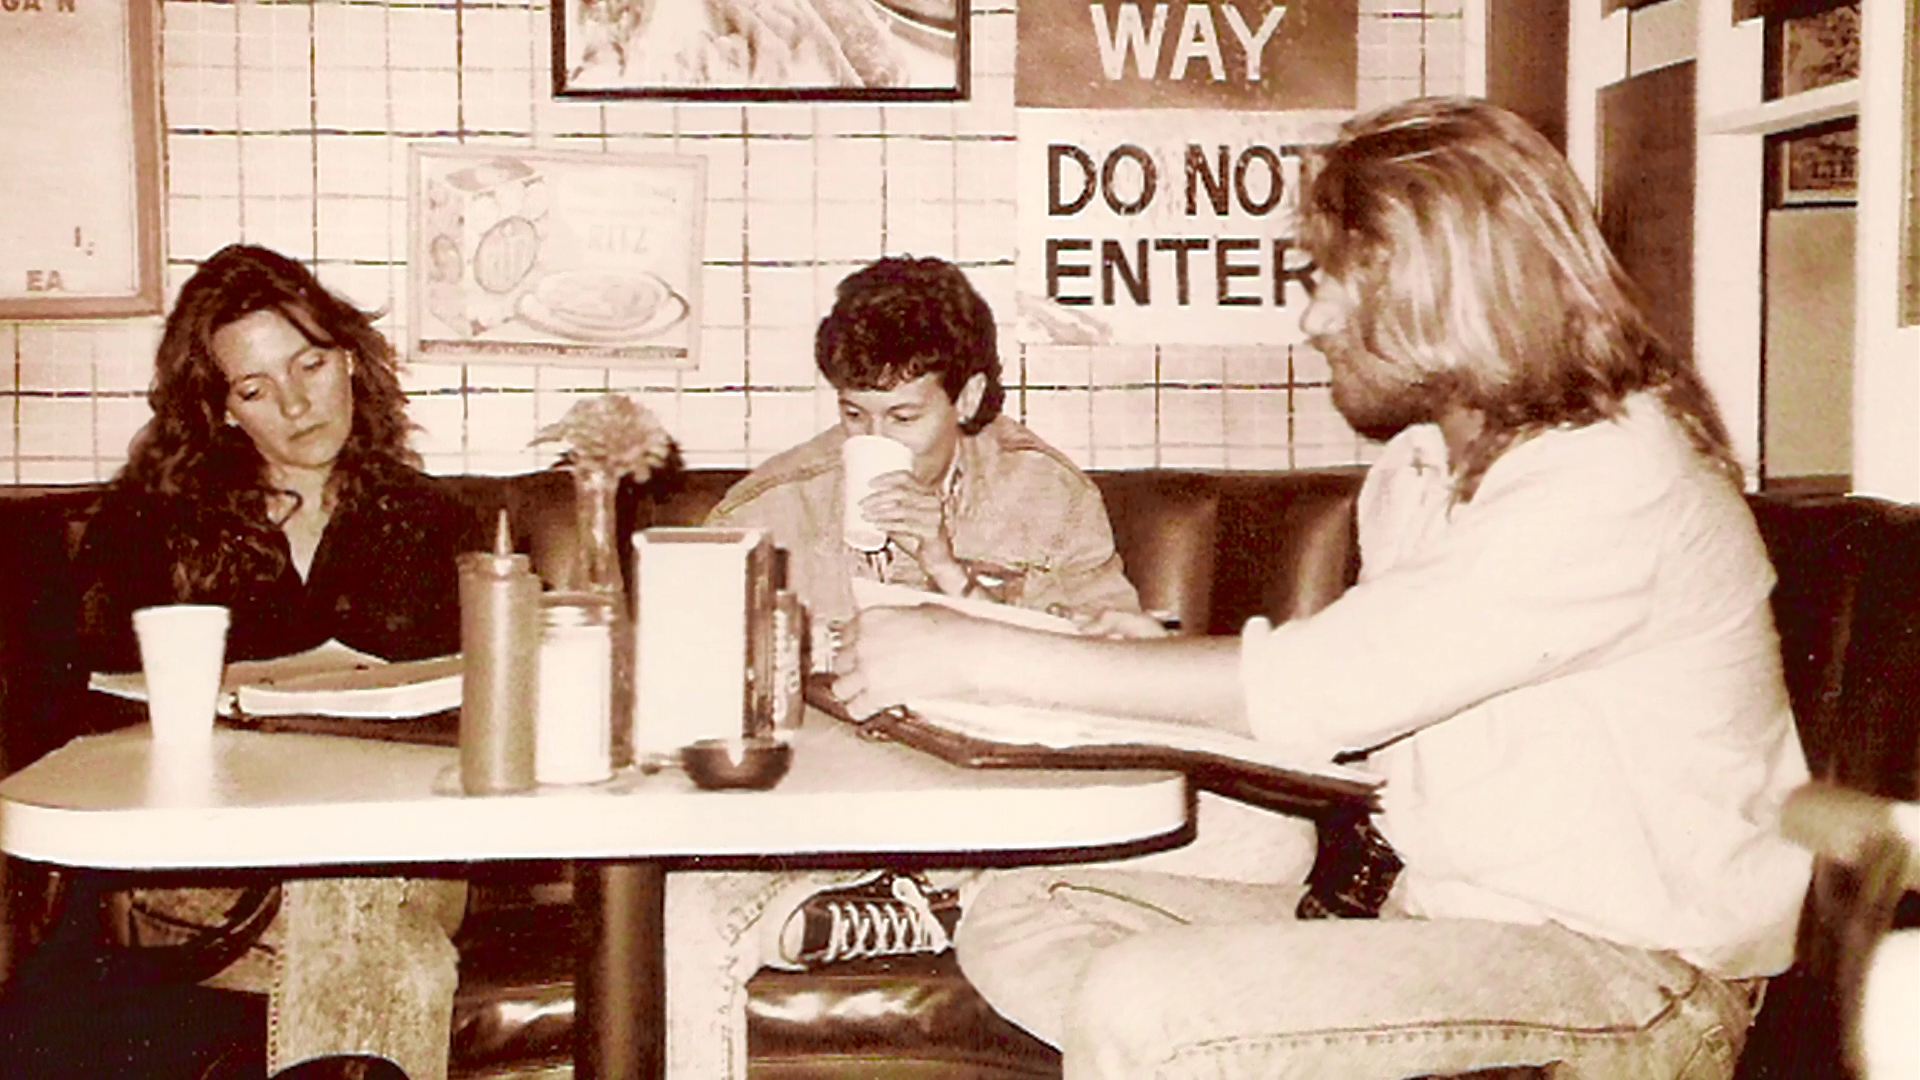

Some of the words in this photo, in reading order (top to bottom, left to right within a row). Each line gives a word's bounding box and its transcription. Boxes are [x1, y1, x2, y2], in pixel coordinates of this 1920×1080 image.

[1090, 2, 1287, 81] WAY
[1048, 144, 1157, 216] DO
[1046, 238, 1320, 306] ENTER
